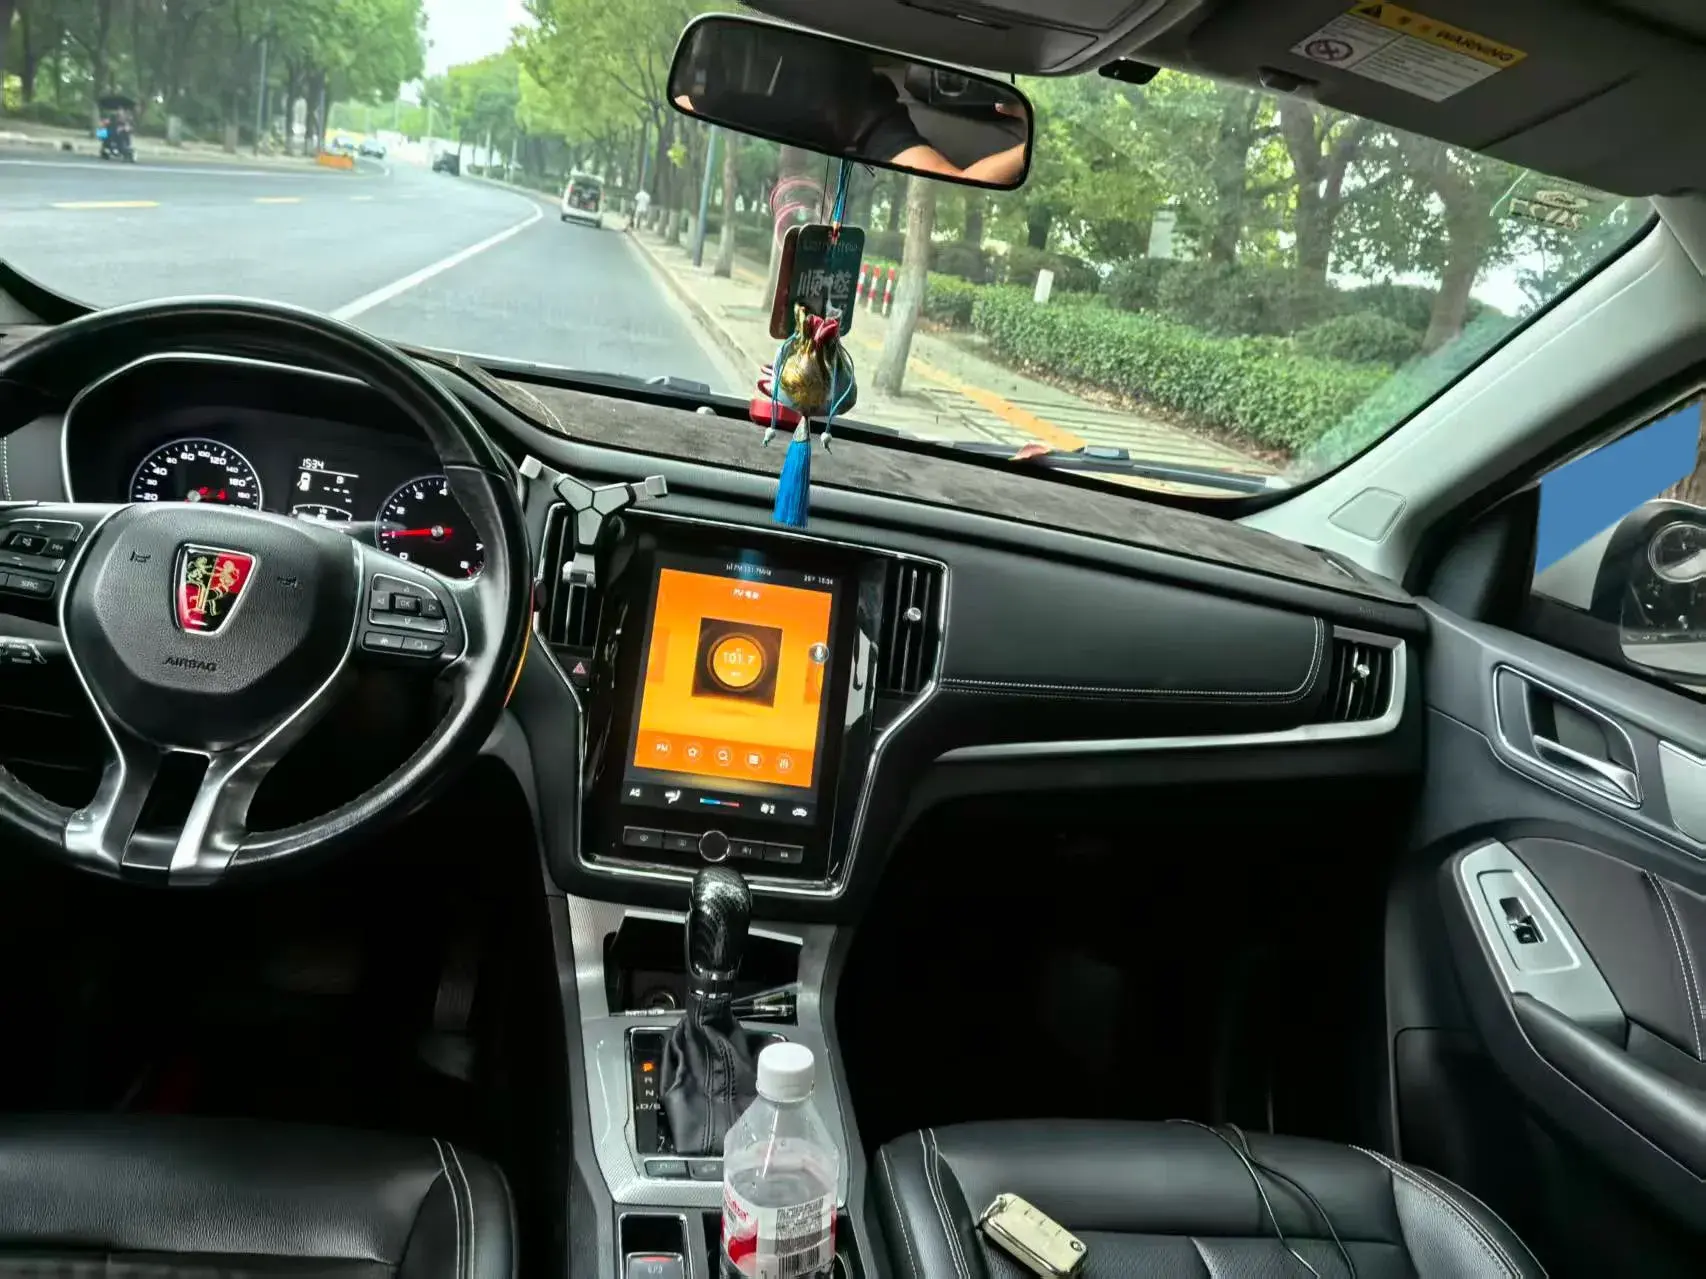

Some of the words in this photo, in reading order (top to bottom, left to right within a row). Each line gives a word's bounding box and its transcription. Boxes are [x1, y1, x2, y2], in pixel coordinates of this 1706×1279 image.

[210, 456, 227, 466] 120
[152, 467, 168, 476] 40
[144, 493, 159, 501] 20
[162, 656, 217, 673] AIRBAG
[645, 1089, 654, 1097] N
